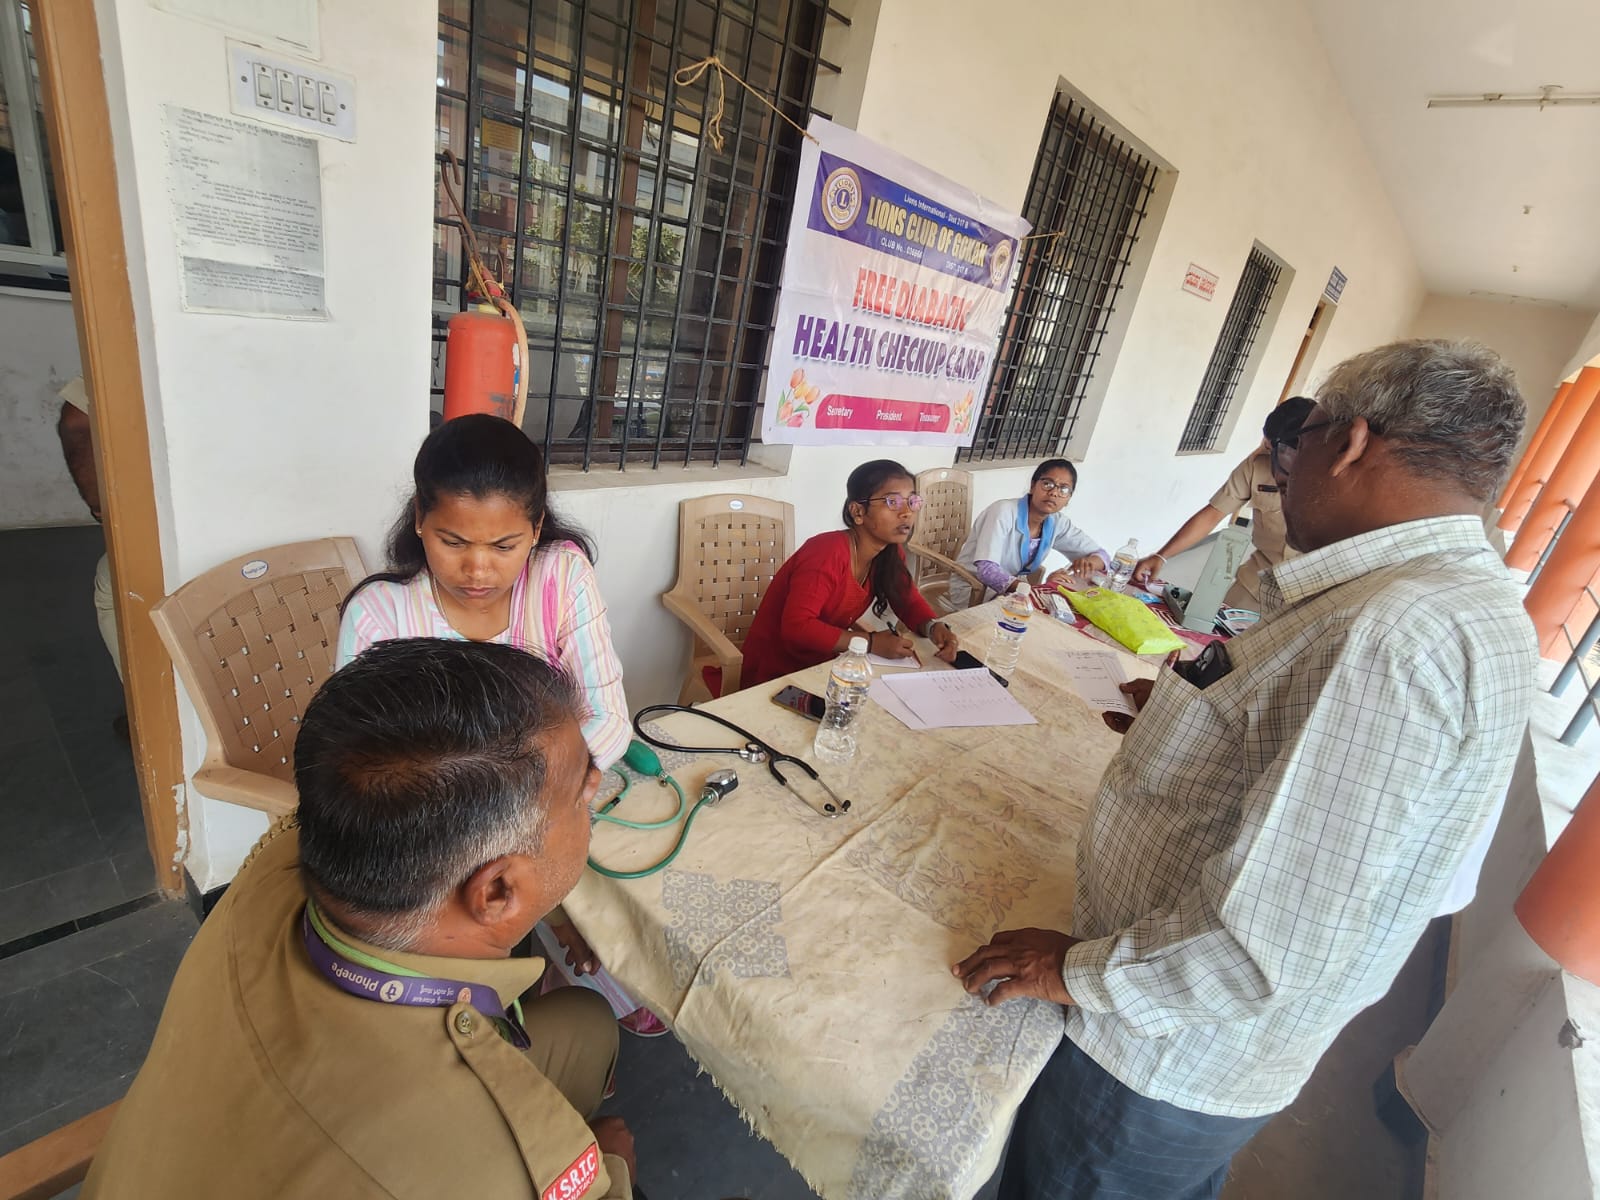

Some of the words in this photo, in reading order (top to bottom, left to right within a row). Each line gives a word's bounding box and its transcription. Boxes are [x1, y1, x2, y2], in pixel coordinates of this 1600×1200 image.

[866, 196, 907, 237] LIONS
[906, 213, 938, 249] CLUB
[937, 226, 954, 254] OF
[880, 237, 896, 250] CLUB
[852, 267, 897, 317] FREE
[895, 280, 973, 332] DIABATIC
[793, 314, 876, 366] HEALTH
[875, 330, 946, 376] CHECKUP
[945, 345, 985, 381] CAMP
[331, 962, 380, 992] PhonePe
